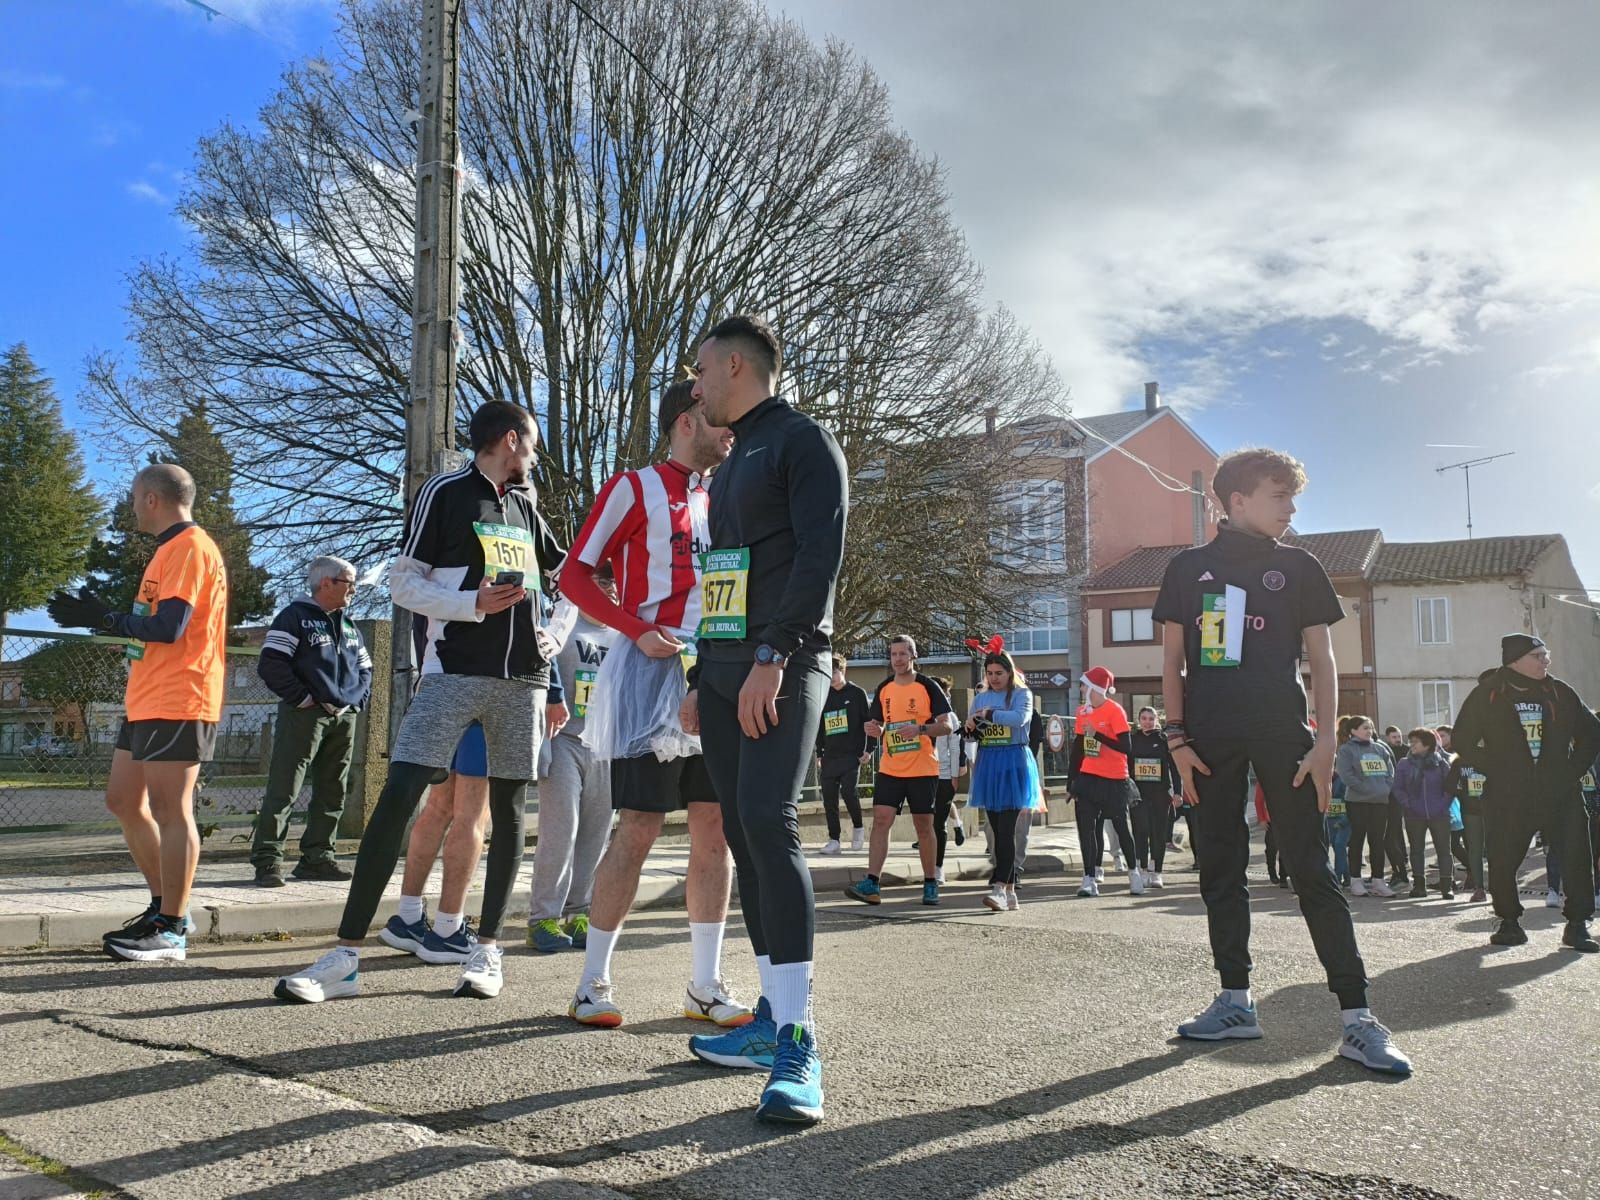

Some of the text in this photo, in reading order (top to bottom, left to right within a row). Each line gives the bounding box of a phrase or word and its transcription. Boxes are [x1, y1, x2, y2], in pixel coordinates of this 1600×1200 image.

[492, 540, 526, 569] 1517
[301, 619, 327, 629] CAMP
[828, 717, 843, 729] 1531
[1138, 765, 1157, 774] 1676
[1365, 761, 1382, 770] 1621
